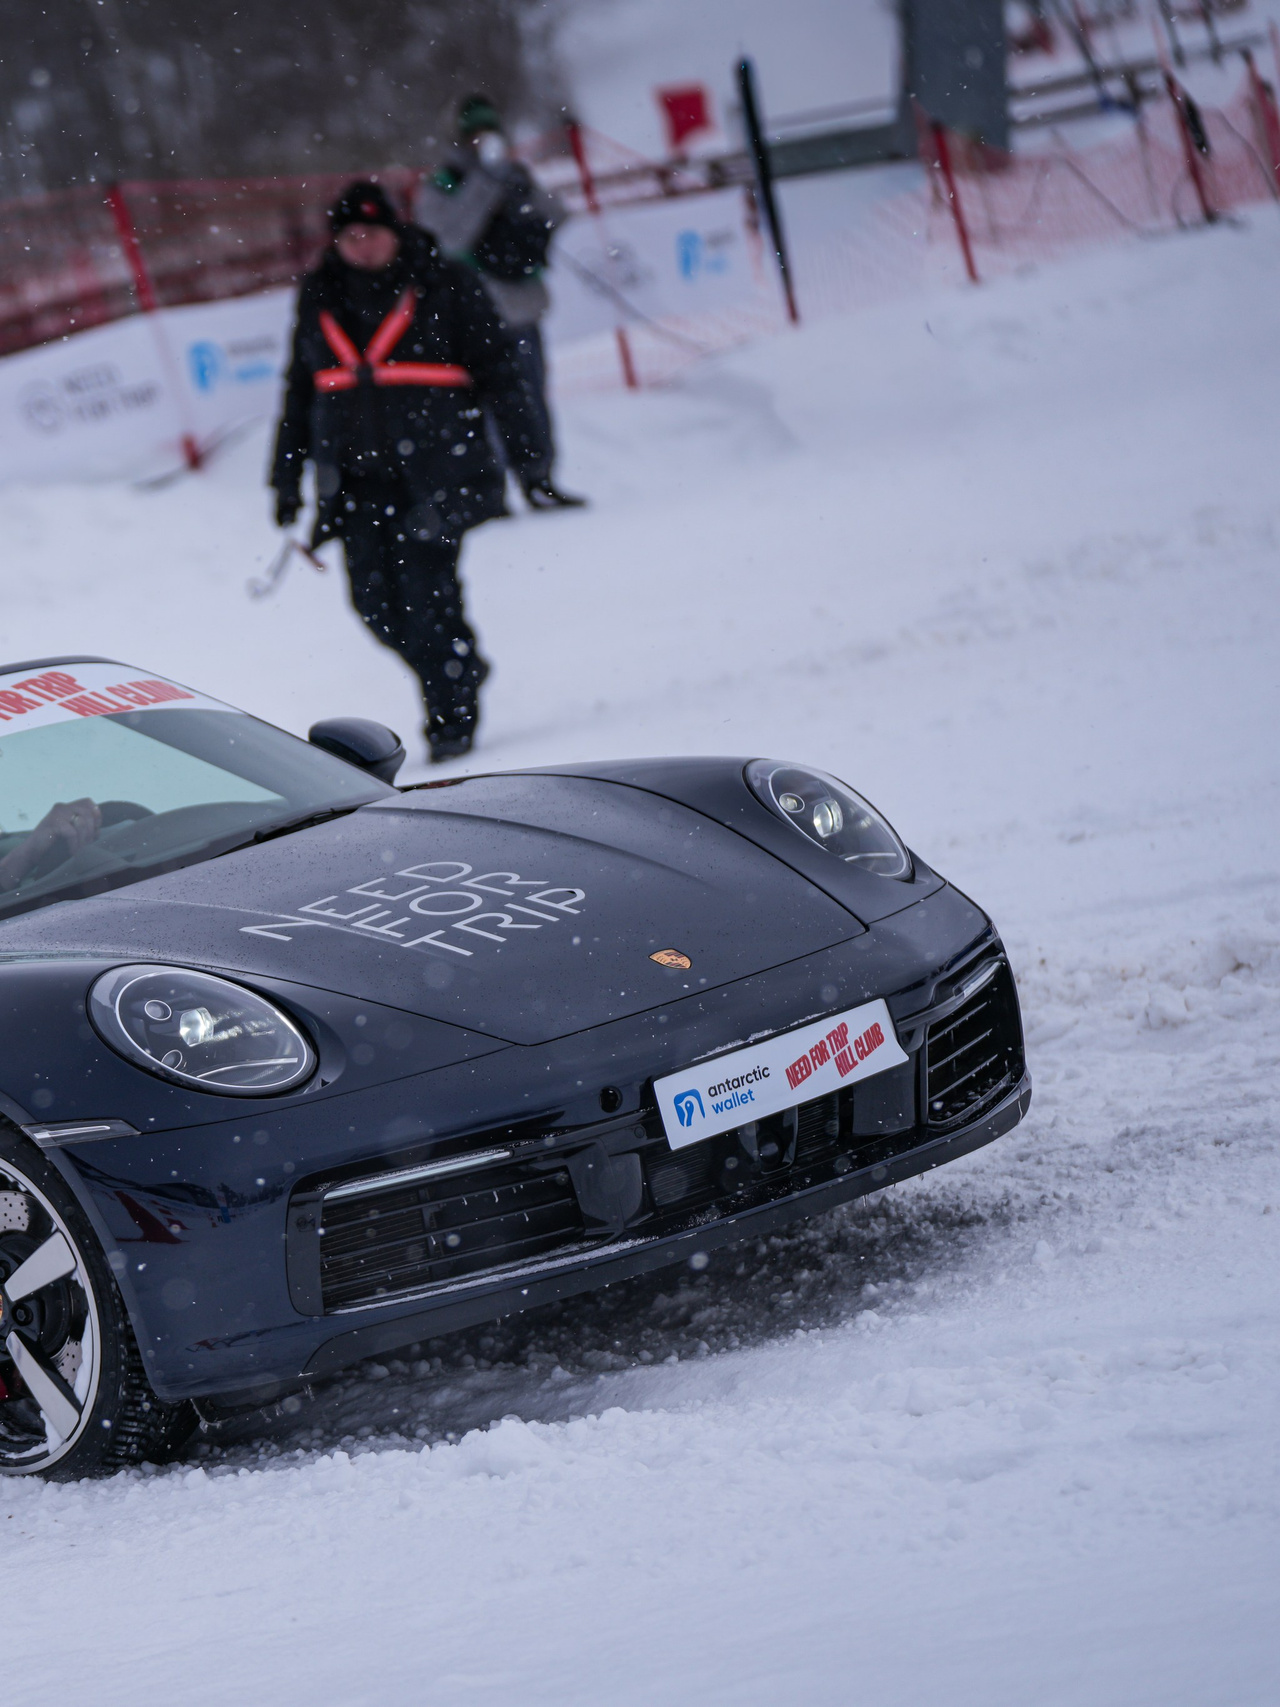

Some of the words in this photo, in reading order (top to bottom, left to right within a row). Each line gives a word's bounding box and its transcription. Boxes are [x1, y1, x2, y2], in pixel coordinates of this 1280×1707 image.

[11, 671, 87, 702] TRIP
[57, 691, 136, 717] HILL
[105, 680, 195, 706] CLIMB
[238, 861, 473, 941] NEED
[350, 871, 550, 938] FOR
[400, 888, 586, 956] TRIP
[785, 1054, 813, 1091] NEED
[808, 1039, 831, 1071] FOR
[826, 1021, 849, 1056] TRIP
[834, 1045, 859, 1078] HILL
[854, 1022, 885, 1061] CLIMB
[707, 1065, 771, 1098] antarctic
[711, 1088, 755, 1114] wallet
